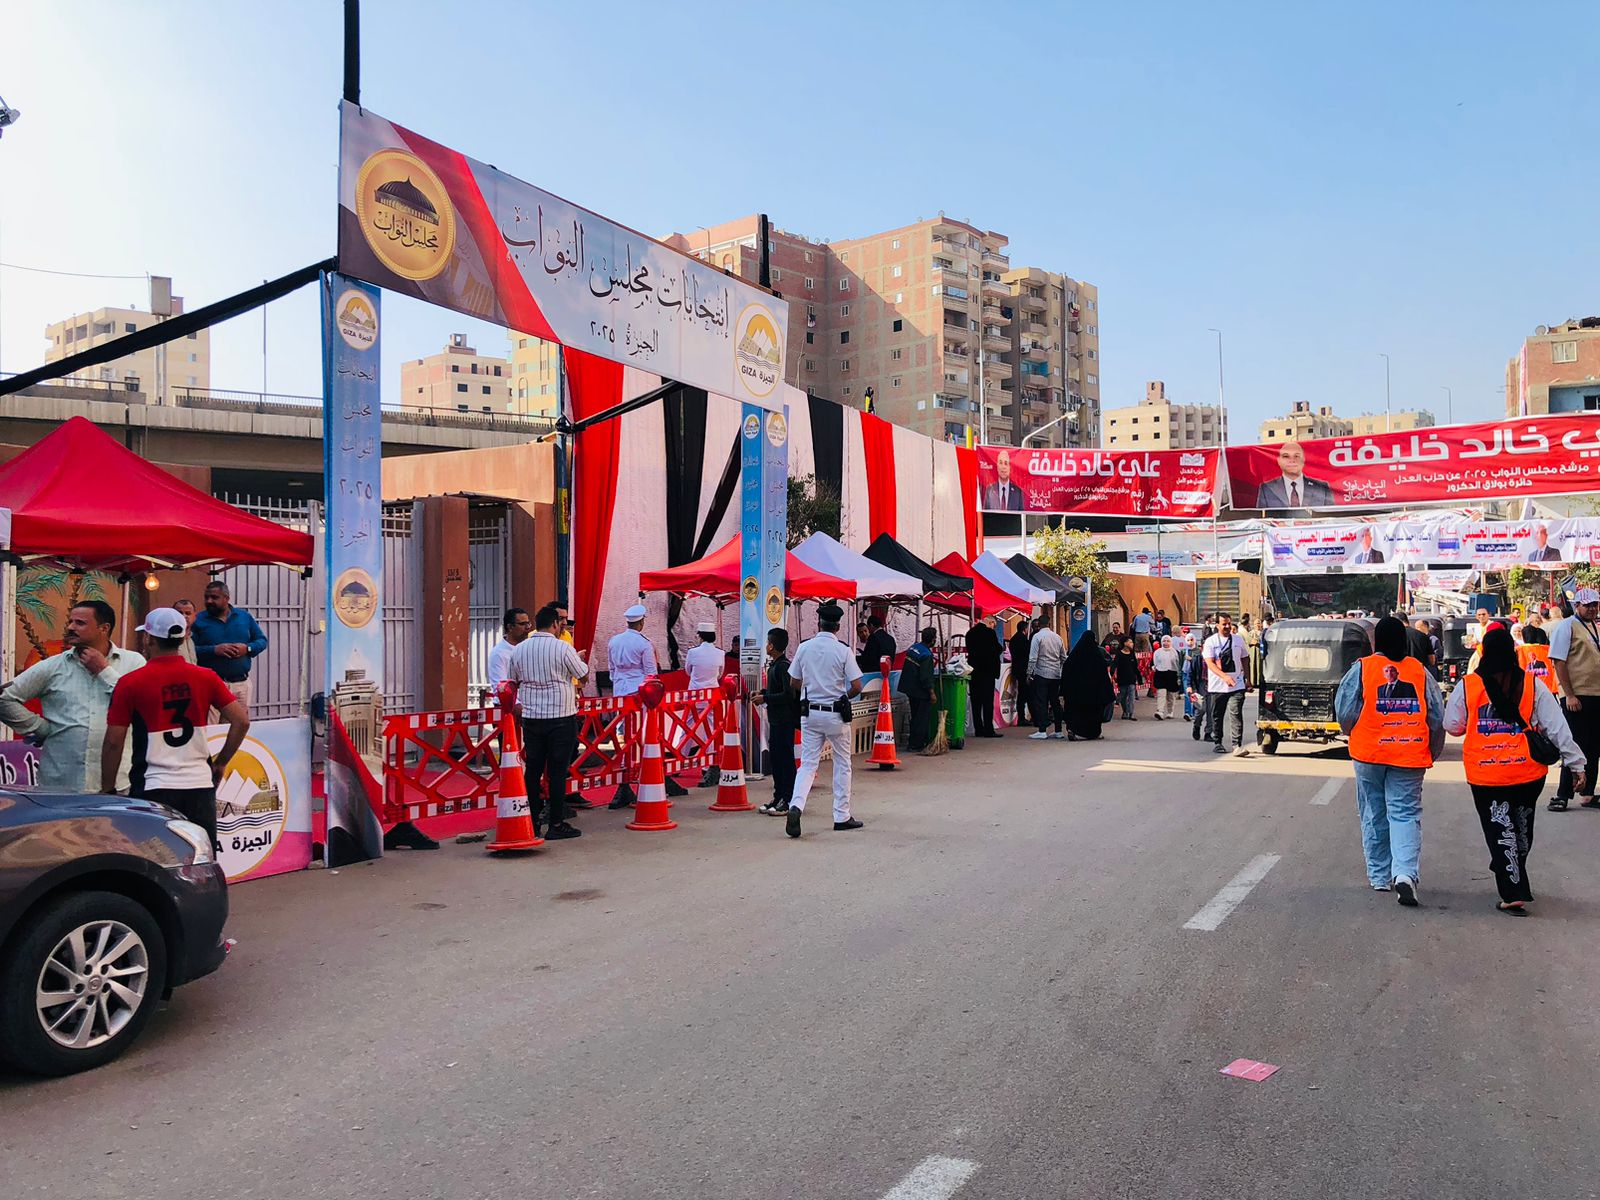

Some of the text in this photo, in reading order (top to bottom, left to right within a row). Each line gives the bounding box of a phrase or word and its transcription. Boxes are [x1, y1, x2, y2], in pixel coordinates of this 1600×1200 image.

[374, 211, 439, 253] مجلس النواب
[501, 204, 585, 285] النواب
[588, 243, 654, 309] مجلس
[342, 328, 356, 337] GIZA
[590, 321, 659, 360] الجيزة ٢٠٢٥
[741, 365, 757, 378] GIZA
[759, 371, 775, 386] الجيزة
[1459, 426, 1550, 459] خالد
[1329, 434, 1450, 471] خليفة
[1028, 452, 1160, 484] علي خالد خليفة
[1491, 467, 1521, 479] النواب
[1522, 465, 1558, 477] مجلس
[1559, 461, 1589, 474] مرشح
[1394, 473, 1422, 485] العدل
[1423, 472, 1445, 483] حزب
[1446, 471, 1461, 481] عن
[1464, 469, 1487, 479] ٢٠٢٥
[339, 479, 373, 499] ٢٠٢٥
[1483, 479, 1507, 491] بولاق
[1508, 478, 1533, 489] دائرة
[1131, 489, 1145, 499] رقم
[1133, 500, 1142, 512] ١٤
[1512, 526, 1531, 538] محمد
[162, 700, 194, 748] 3
[723, 771, 739, 781] مرور
[232, 830, 272, 853] الجيزة
